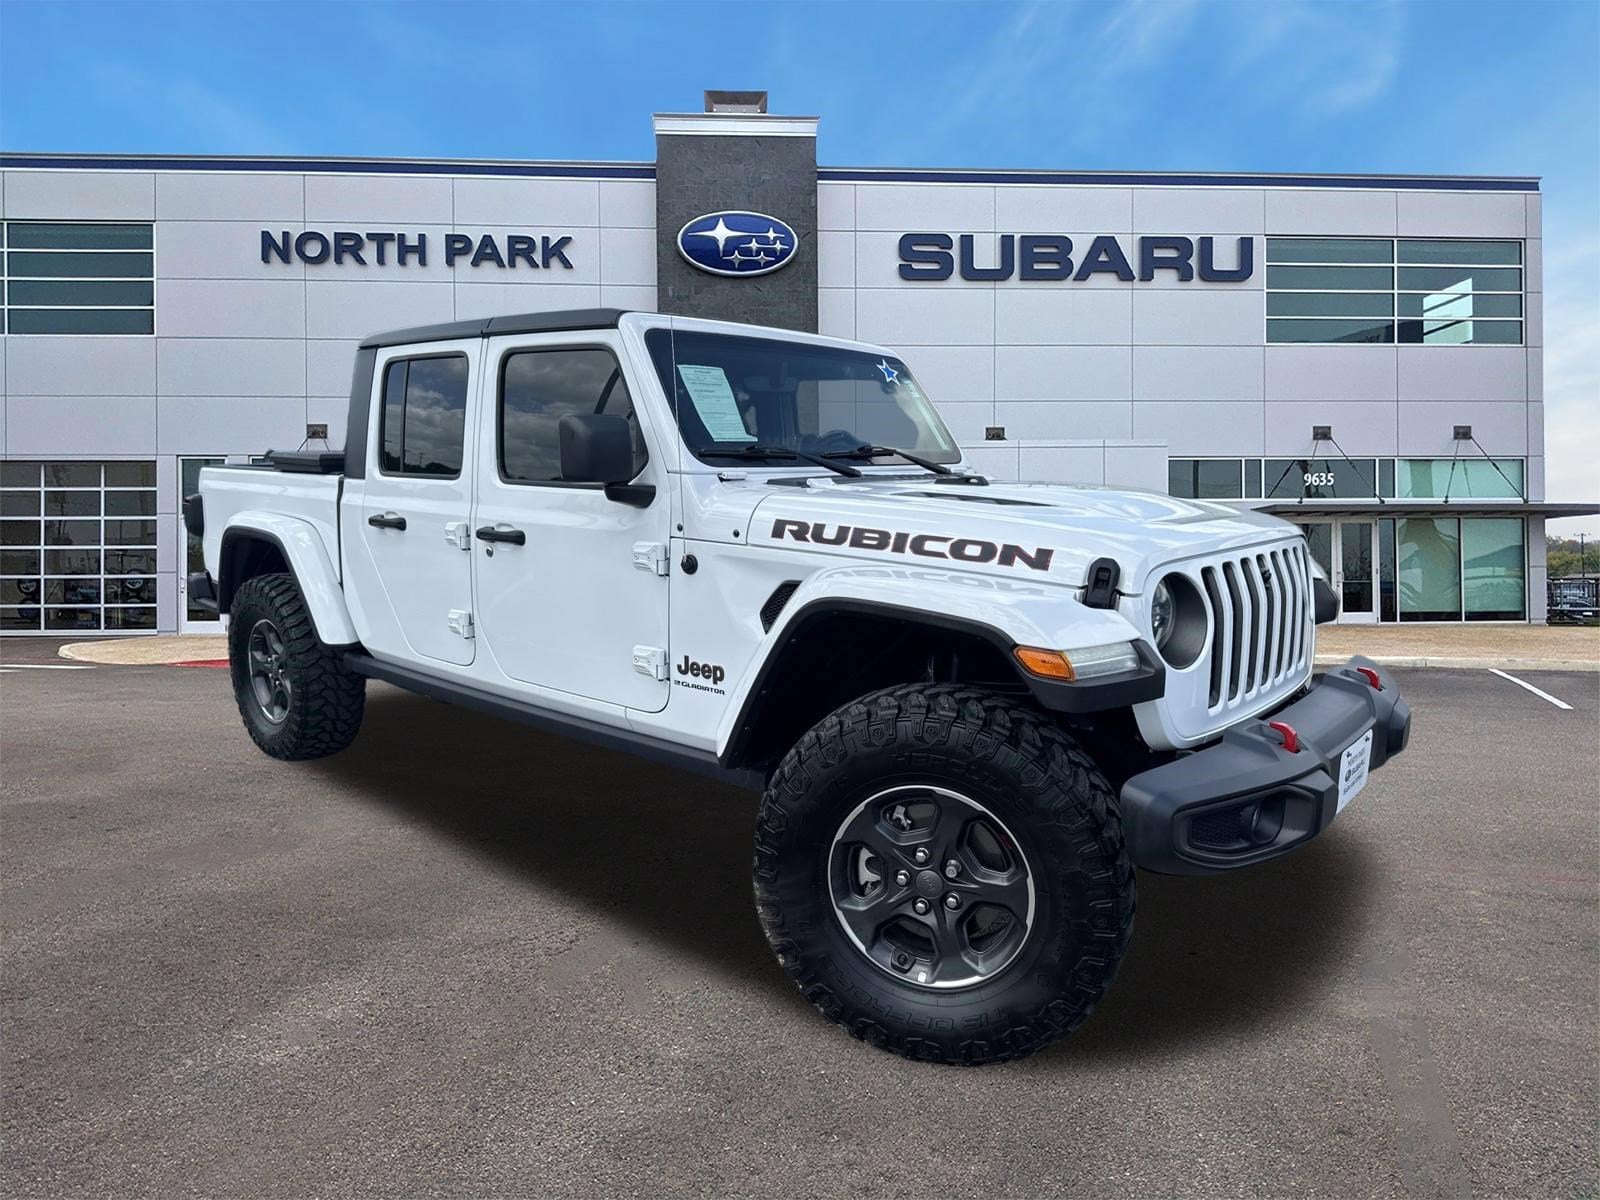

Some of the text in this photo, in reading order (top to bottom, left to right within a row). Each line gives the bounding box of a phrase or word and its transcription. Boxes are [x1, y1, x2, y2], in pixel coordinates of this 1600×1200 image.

[260, 230, 573, 269] NORTH PARK
[898, 233, 1253, 282] SUBARU
[1303, 472, 1335, 486] 9635
[771, 518, 1054, 571] RUBICON
[677, 655, 725, 685] Jeep
[681, 681, 726, 696] GLADIATOR
